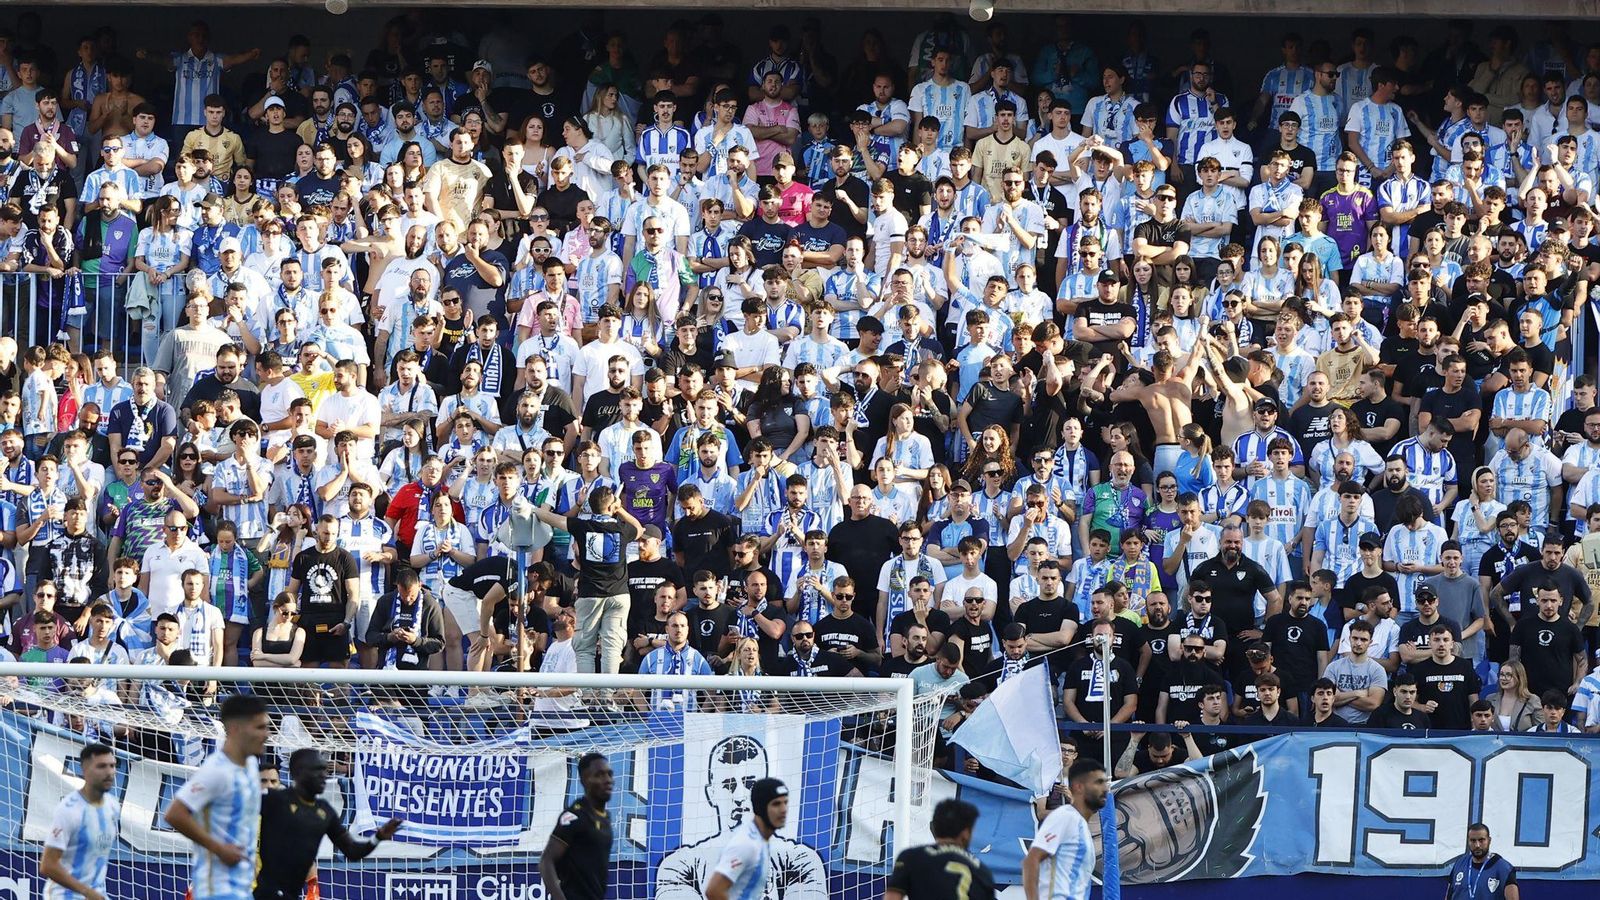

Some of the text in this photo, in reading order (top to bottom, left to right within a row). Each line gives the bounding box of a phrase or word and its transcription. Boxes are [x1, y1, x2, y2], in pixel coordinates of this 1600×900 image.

[357, 735, 521, 782] SANCIONADOS
[366, 776, 504, 818] PRESENTES
[1308, 741, 1600, 872] 190
[476, 875, 551, 900] Ciud
